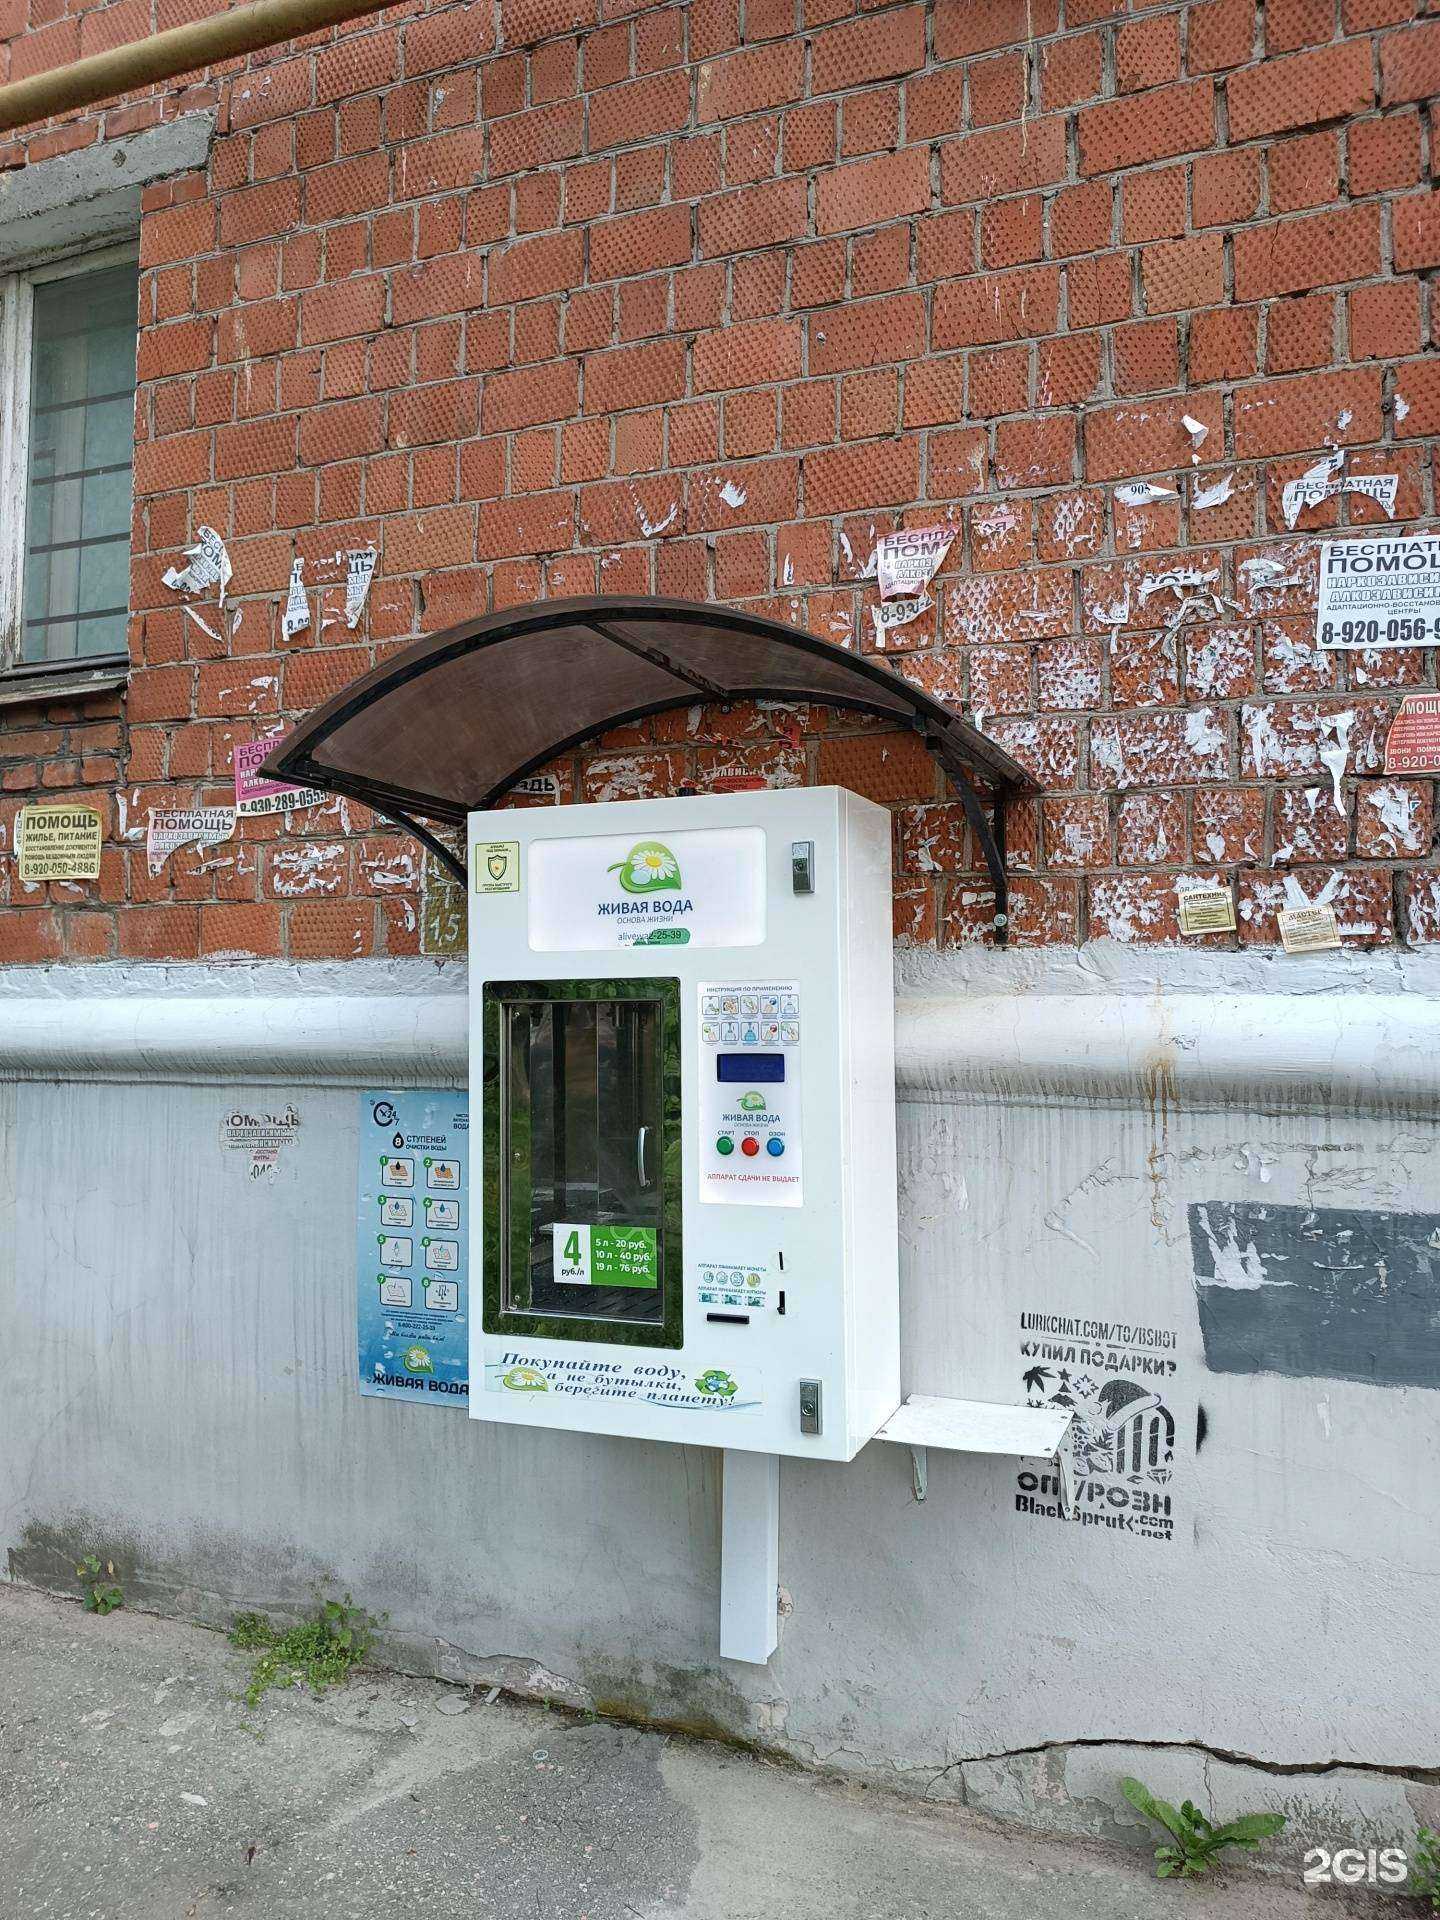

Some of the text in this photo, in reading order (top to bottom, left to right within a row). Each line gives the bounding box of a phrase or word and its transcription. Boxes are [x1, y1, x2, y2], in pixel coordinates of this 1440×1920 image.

[1330, 541, 1440, 557] БЕСПЛАТ
[1387, 608, 1421, 616] ЦЕНТРЫ
[155, 809, 234, 818] БЕСПЛАТНАЯ
[26, 814, 98, 830] ПОМОЩЬ
[153, 818, 232, 832] ПОМОЩЬ
[25, 831, 97, 842] ЖИЛЬЕ, ПИТАНИЕ
[24, 862, 96, 875] 8-920-050-4886
[1183, 891, 1227, 901] САНТЕХНИК
[598, 899, 693, 916] ЖИВАЯ ВОДА
[616, 914, 674, 924] ОСНОВА ЖИЗНИ
[722, 1114, 781, 1124] ЖИВАЯ ВОДА
[406, 1134, 446, 1144] СТУПЕНЕЙ
[738, 1174, 760, 1182] СДАЧИ
[564, 1231, 581, 1266] 4
[595, 1239, 601, 1247] 5
[615, 1240, 627, 1249] 20
[628, 1241, 647, 1250] руб.
[595, 1251, 605, 1259] 10
[619, 1252, 631, 1260] 40
[633, 1252, 652, 1263] руб.
[561, 1268, 585, 1276] руб./л
[595, 1263, 605, 1271] 19
[620, 1264, 631, 1272] 76
[632, 1265, 650, 1275] руб.
[1020, 1340, 1177, 1378] КУПИЛ ПОДАРКИ?
[501, 1352, 687, 1381] Покупайте воду,
[372, 1373, 469, 1396] ЖИВАЯ ВОДА
[547, 1372, 682, 1392] а не бутылки,
[554, 1381, 735, 1408] берегите планету!
